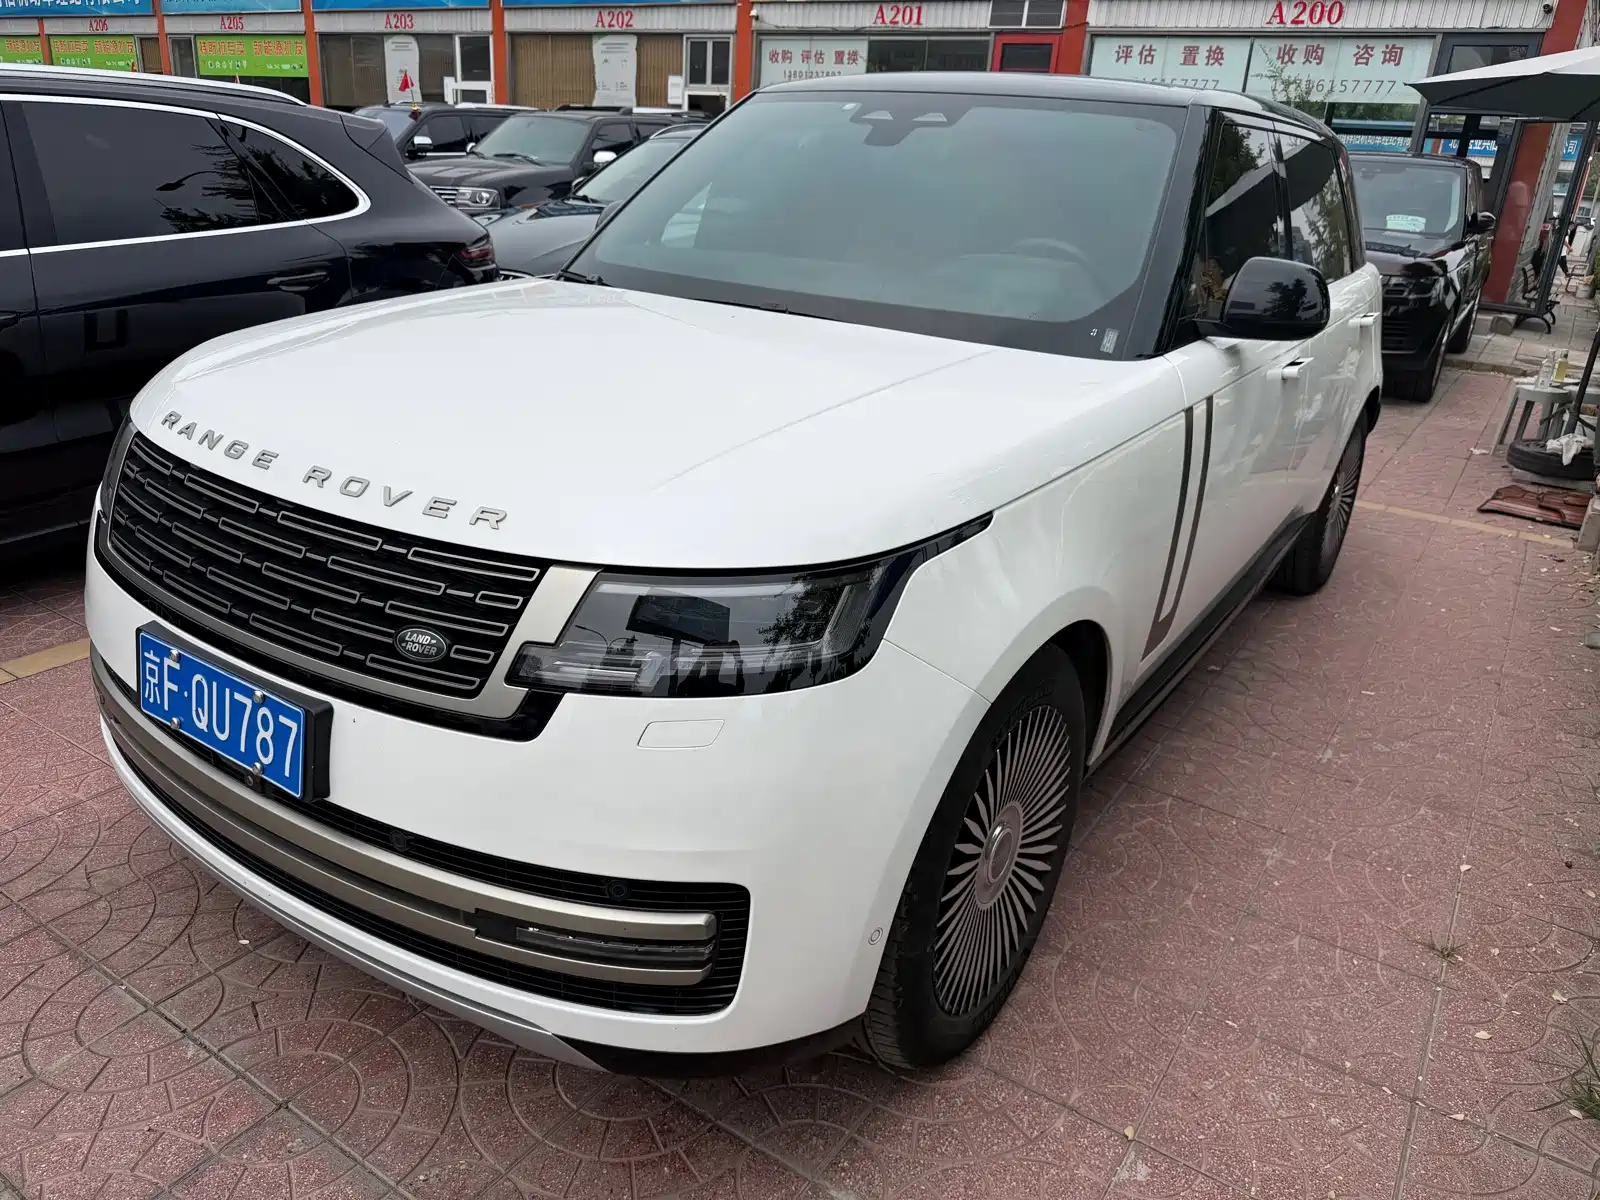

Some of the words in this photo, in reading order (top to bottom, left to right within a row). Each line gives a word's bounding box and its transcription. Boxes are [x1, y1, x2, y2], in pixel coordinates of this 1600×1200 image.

[219, 15, 245, 31] A205
[384, 12, 414, 30] A203
[595, 10, 634, 29] A202
[874, 5, 923, 26] A201
[1267, 1, 1345, 25] A200
[88, 18, 109, 32] A206
[768, 48, 794, 65] 收购
[800, 48, 826, 65] 评估
[833, 49, 860, 66] 置换
[1115, 43, 1157, 65] 评估
[1179, 44, 1226, 66] 置换
[1275, 43, 1326, 66] 收购
[1352, 43, 1405, 67] 咨询
[160, 410, 279, 470] RANGE
[302, 465, 507, 530] ROVER
